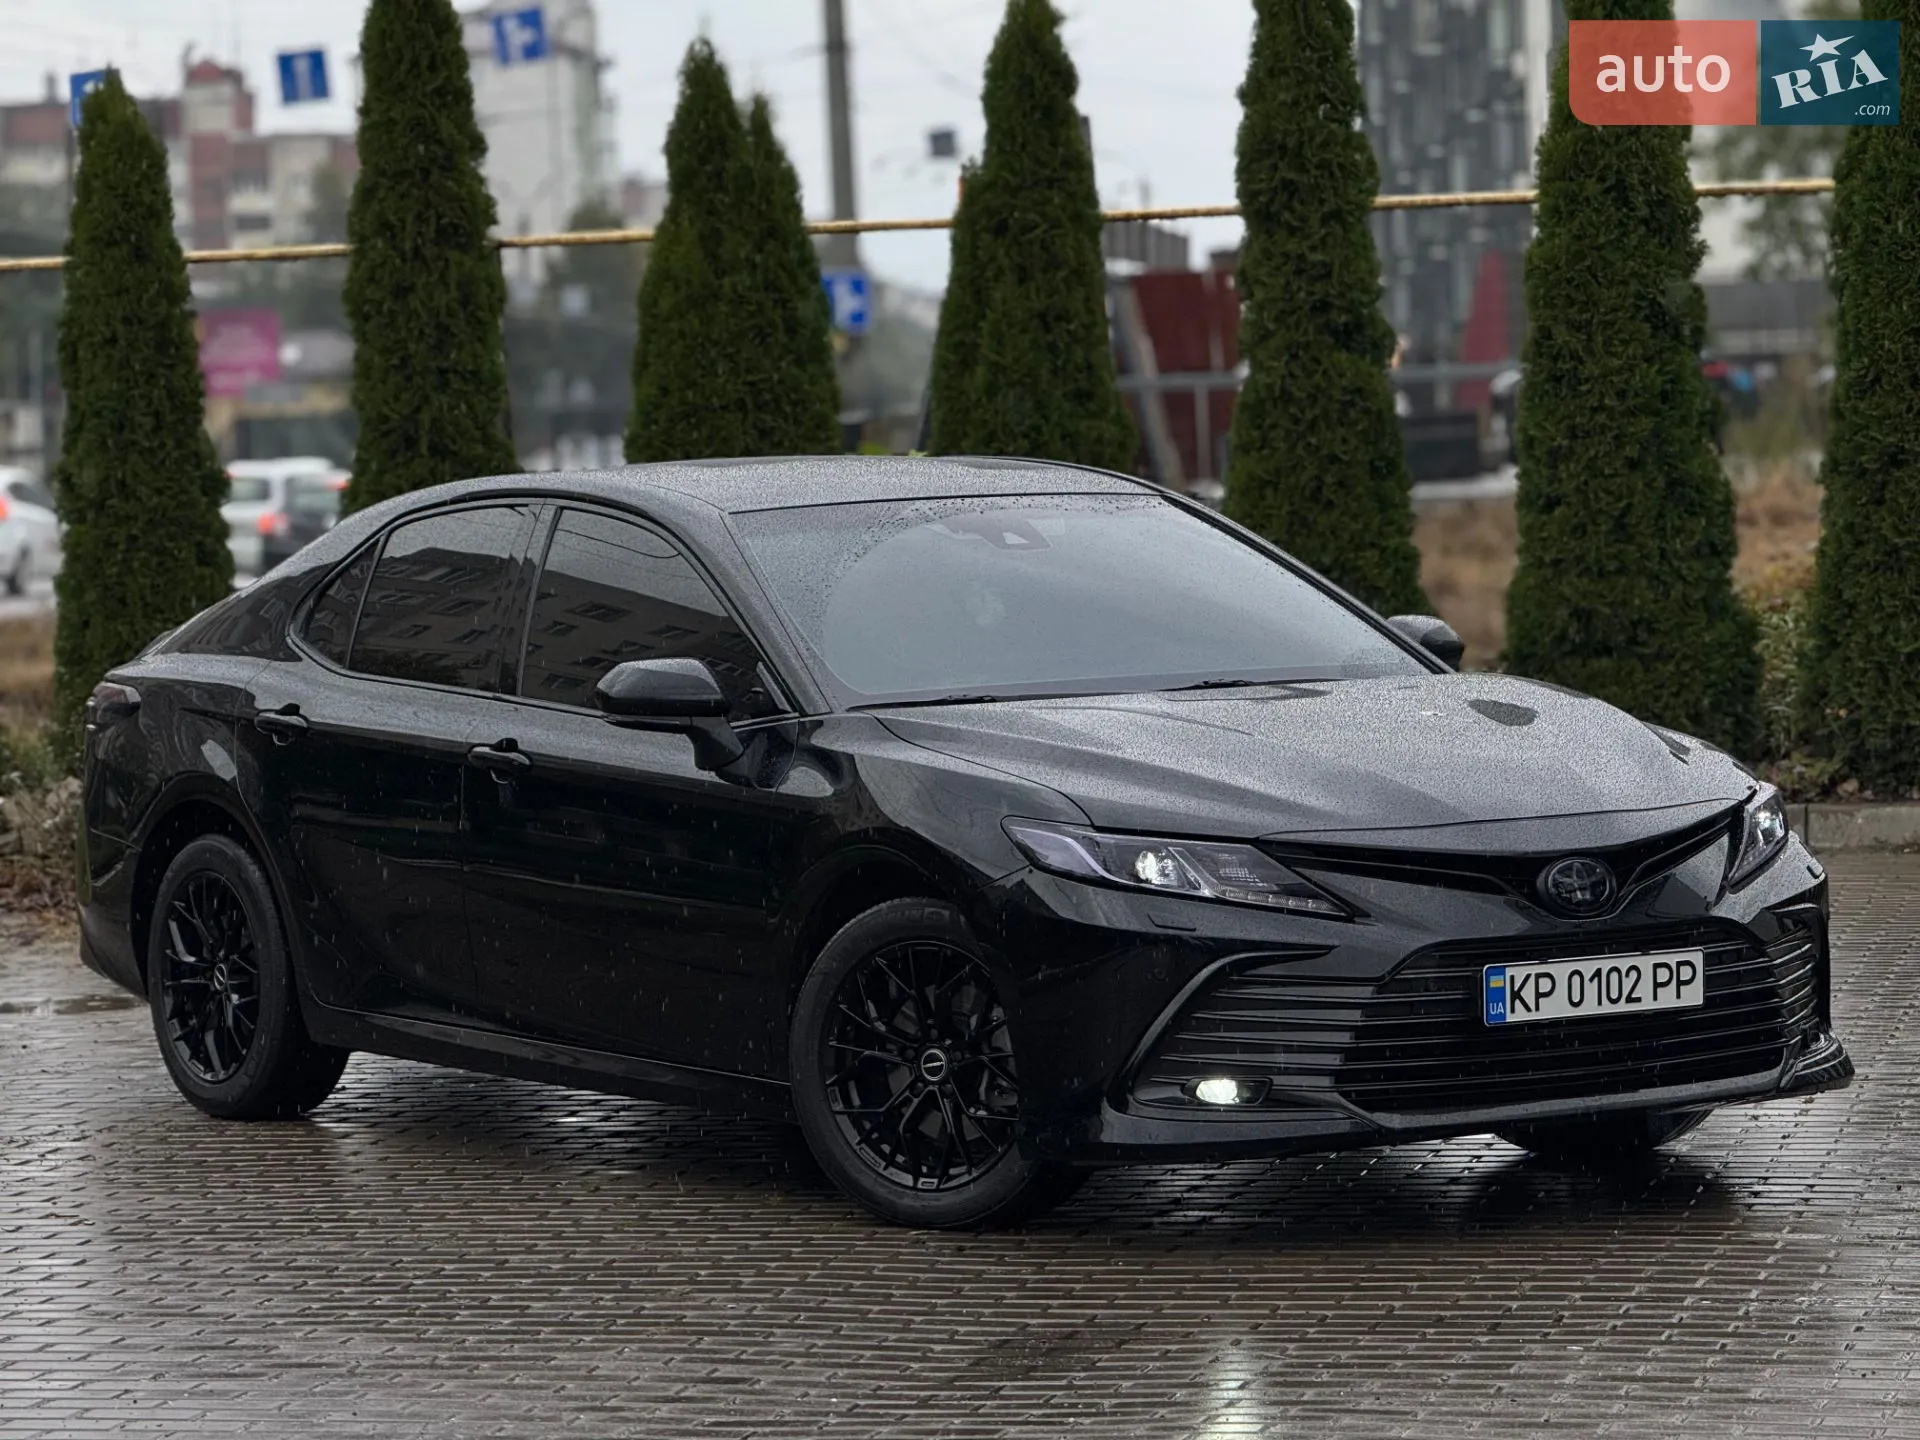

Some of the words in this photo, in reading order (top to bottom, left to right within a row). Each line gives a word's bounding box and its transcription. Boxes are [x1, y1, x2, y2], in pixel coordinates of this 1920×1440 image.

[1509, 971, 1556, 1014] KP
[1567, 965, 1642, 1008] 0102
[1652, 959, 1697, 1002] PP
[1489, 1003, 1504, 1015] UA
